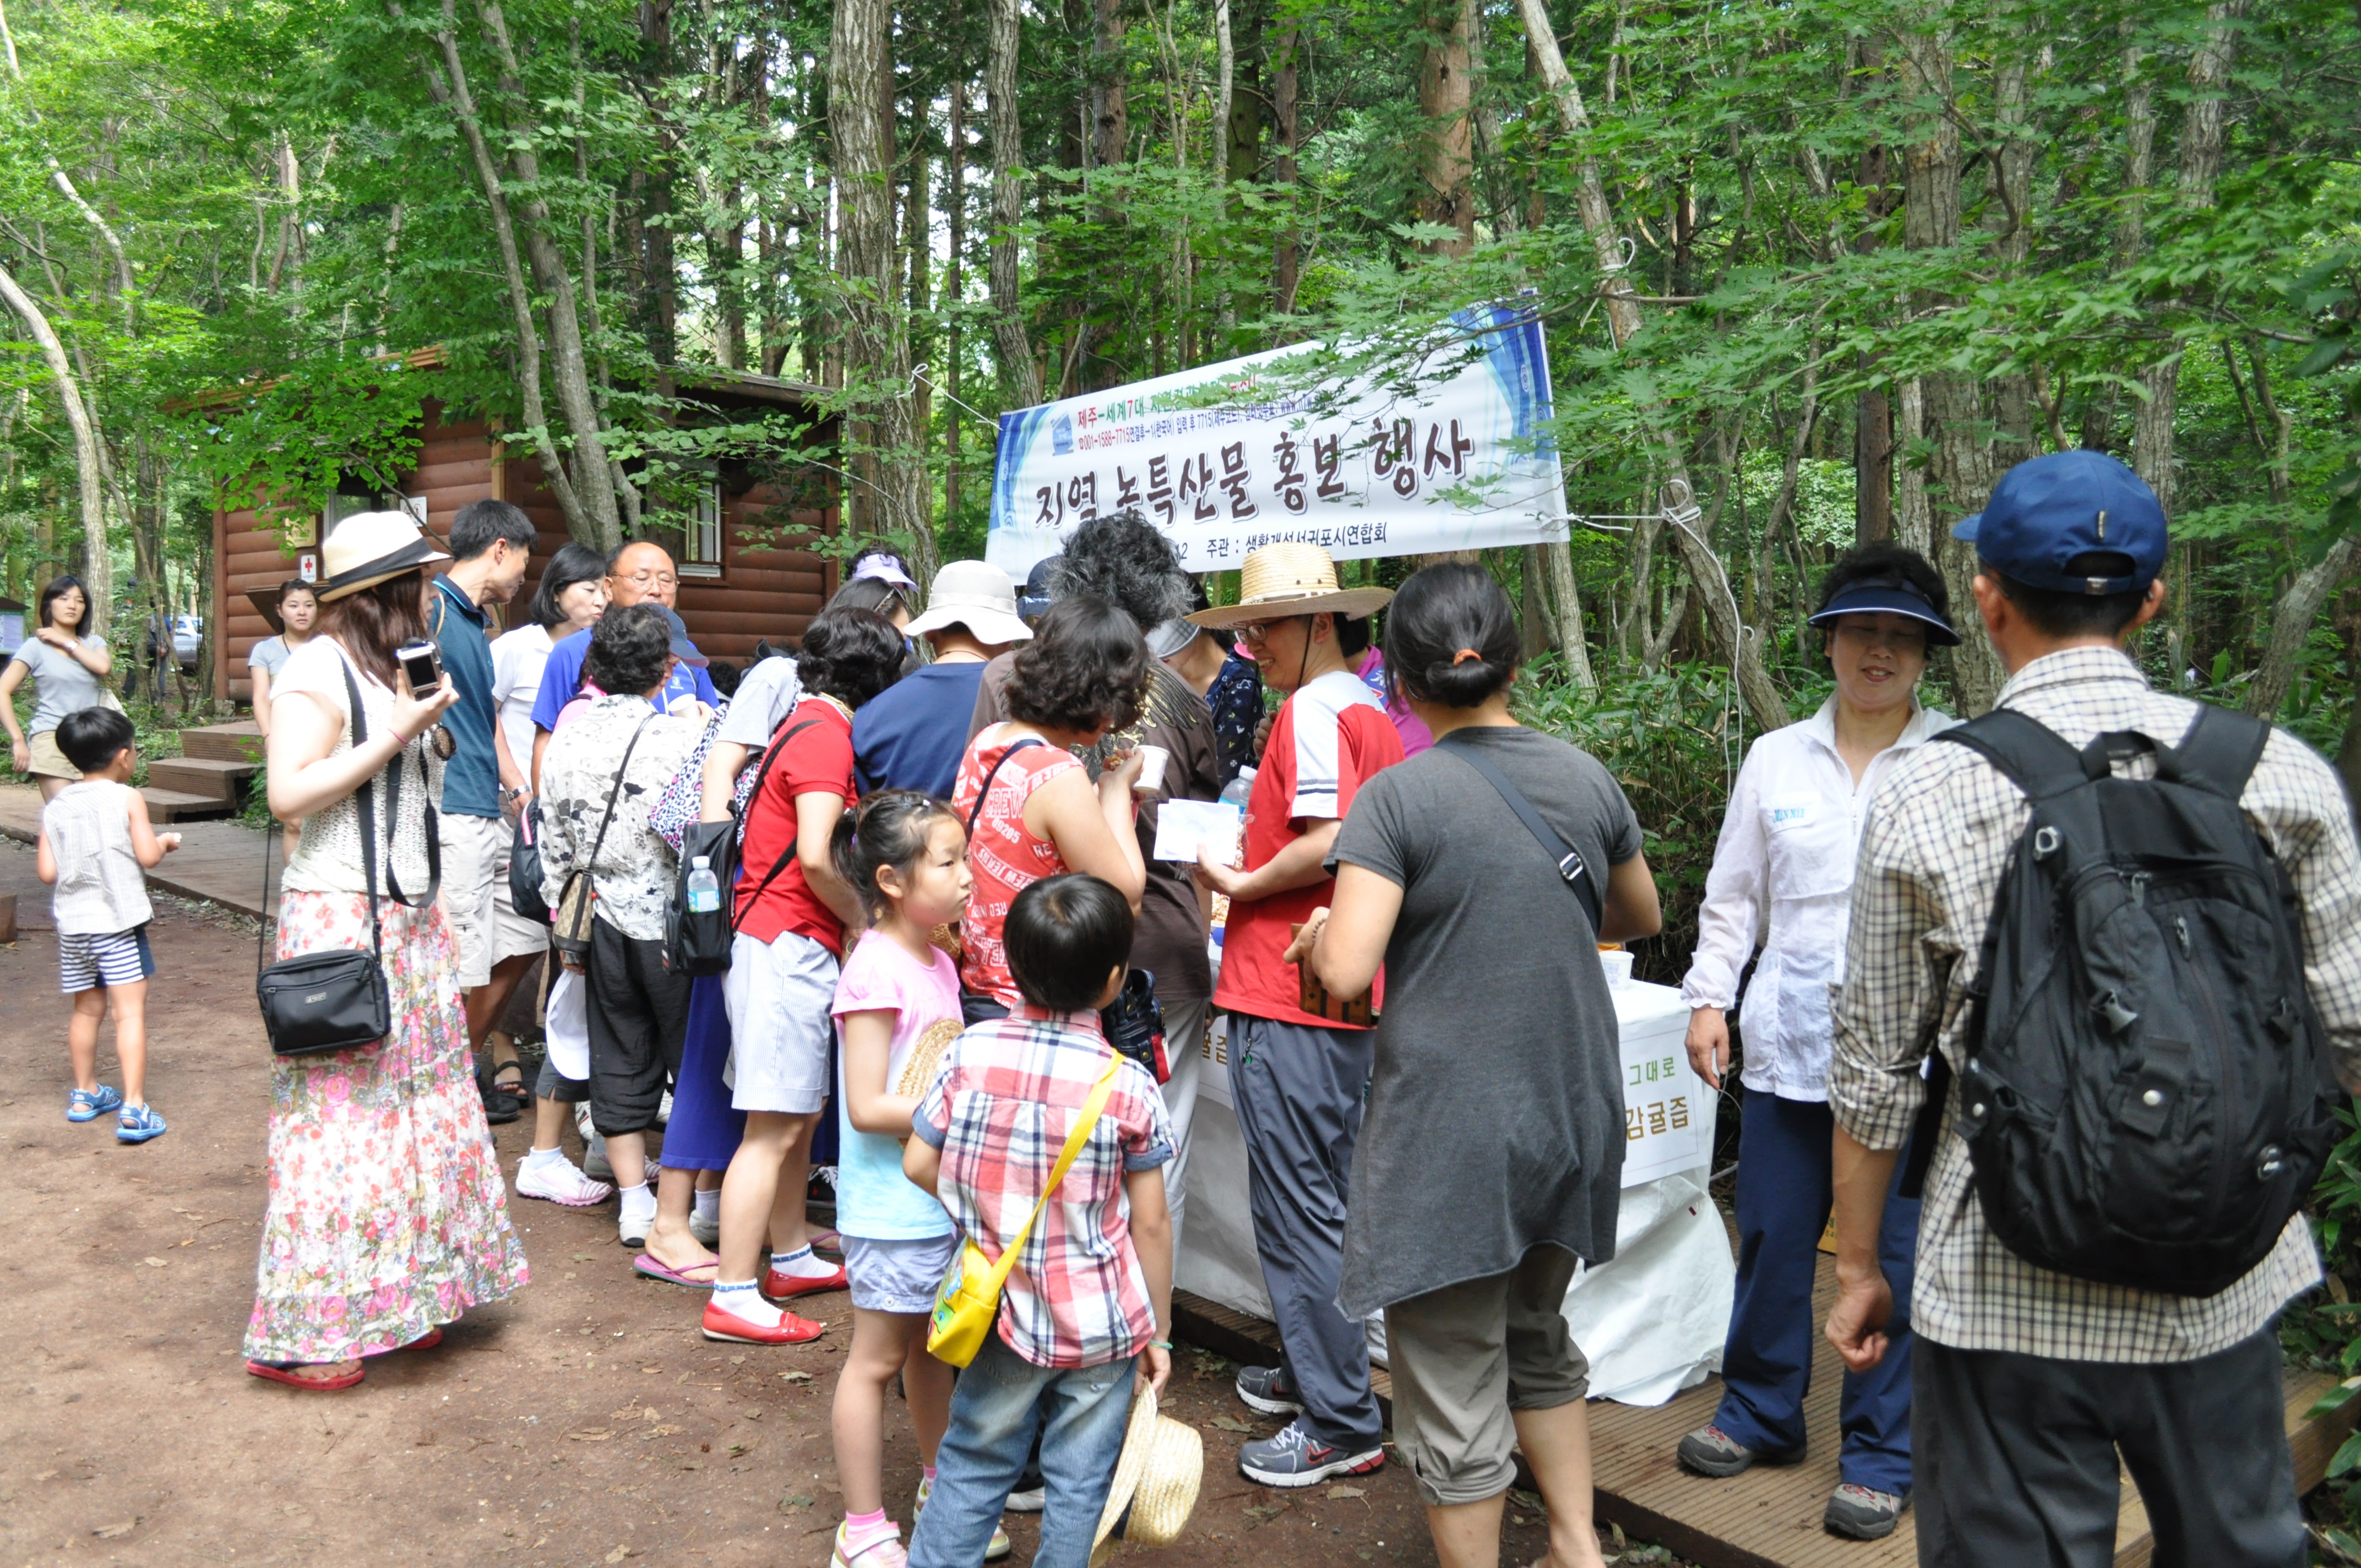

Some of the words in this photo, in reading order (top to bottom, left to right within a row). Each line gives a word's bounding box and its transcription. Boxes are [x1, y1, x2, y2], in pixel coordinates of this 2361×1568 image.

[1176, 416, 1188, 434] 입력
[1190, 414, 1195, 432] 후
[1035, 471, 1098, 526] 지역
[1116, 440, 1257, 525] 농특산물
[1274, 431, 1345, 511] 홍보
[1369, 417, 1471, 496] 행사
[1207, 537, 1229, 559] 주관
[1629, 1057, 1675, 1086] 그대로
[1626, 1096, 1689, 1141] 감귤즙
